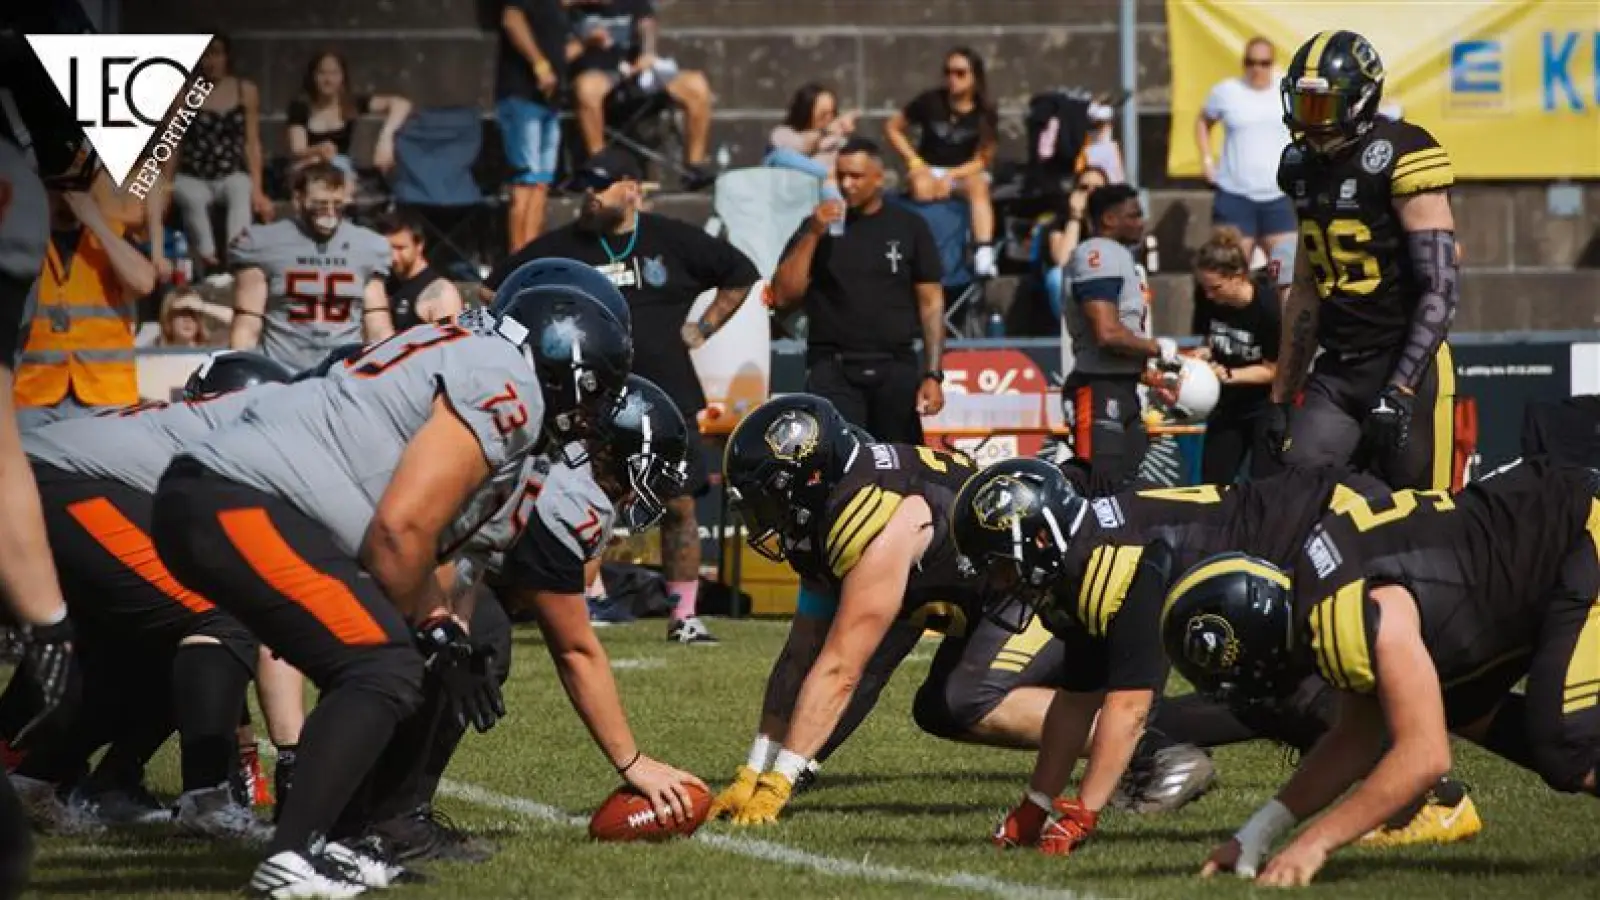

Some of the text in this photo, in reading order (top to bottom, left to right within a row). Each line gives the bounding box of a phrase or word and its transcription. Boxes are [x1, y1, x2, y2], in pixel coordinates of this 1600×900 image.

[1087, 250, 1101, 270] 2
[284, 271, 355, 323] 56
[480, 385, 529, 435] 73
